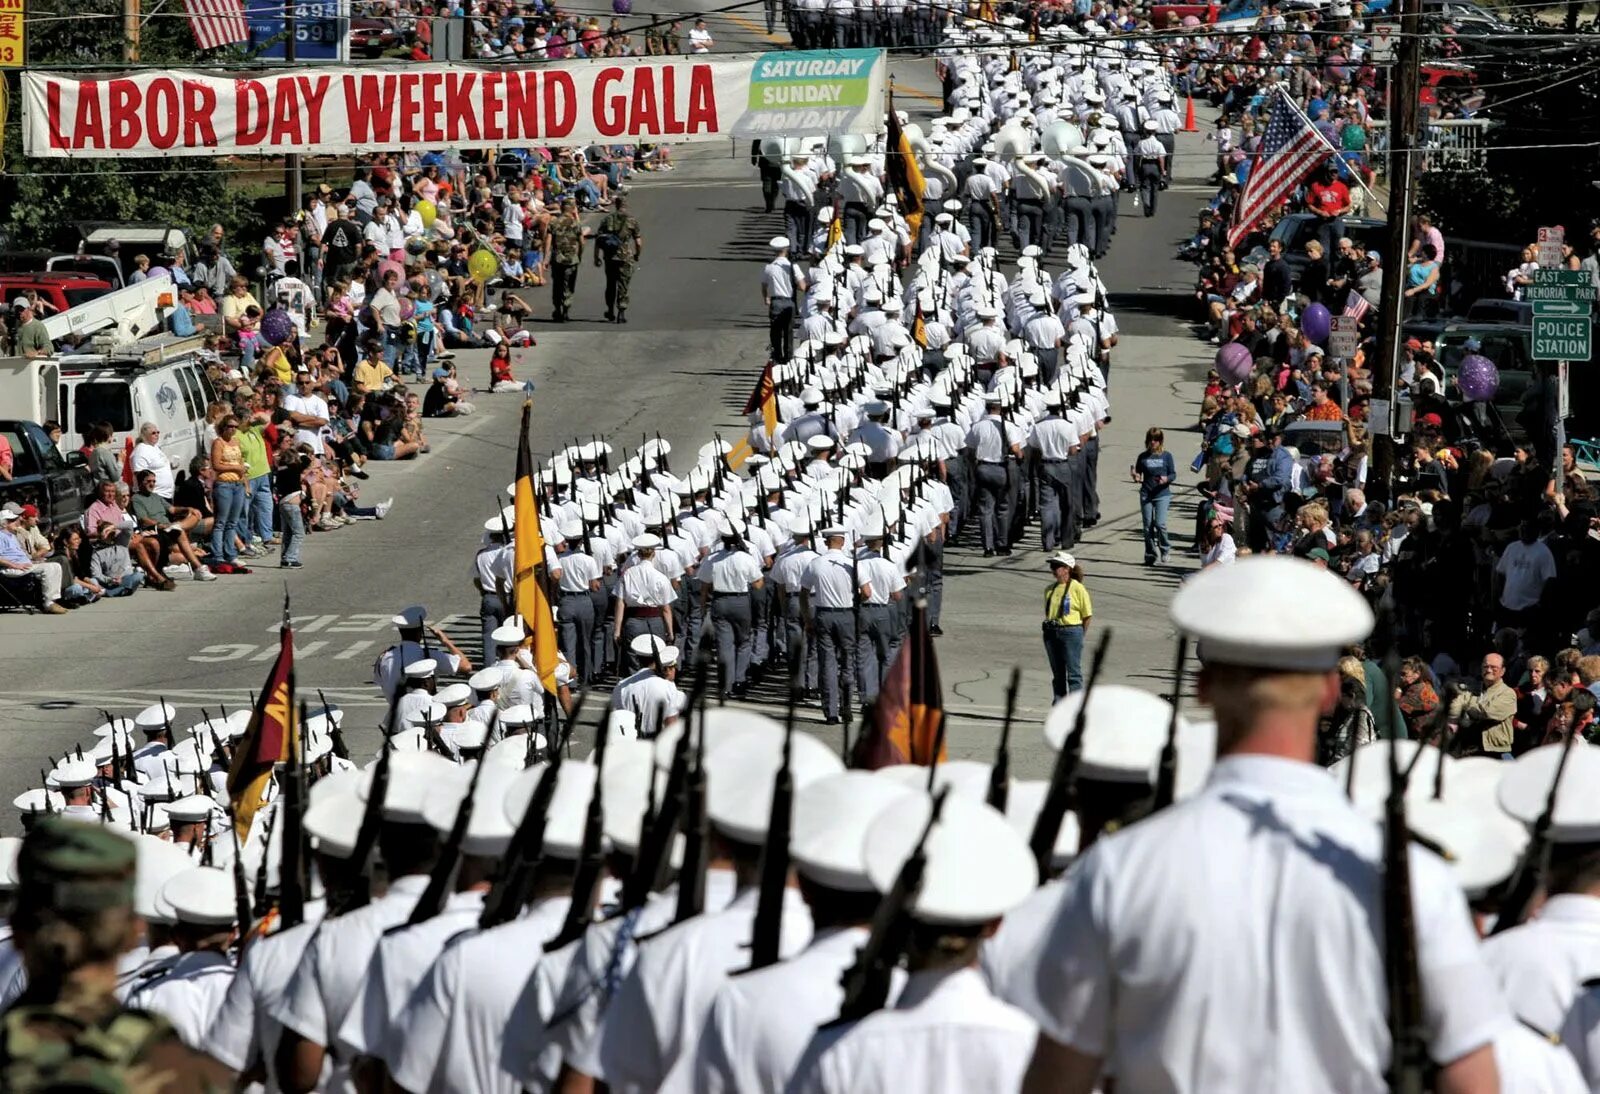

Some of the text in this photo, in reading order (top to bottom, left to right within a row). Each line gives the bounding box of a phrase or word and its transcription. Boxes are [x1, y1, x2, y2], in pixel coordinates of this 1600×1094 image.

[760, 58, 865, 78] SATURDAY
[763, 84, 844, 105] SUNDAY
[46, 64, 719, 150] LABOR DAY WEEKEND GALA
[751, 110, 850, 131] MONDAY
[1534, 271, 1591, 283] EAST ST
[278, 291, 304, 314] 54
[1527, 287, 1596, 300] MEMORIAL PARK
[1538, 322, 1585, 337] POLICE
[1536, 340, 1587, 354] STATION
